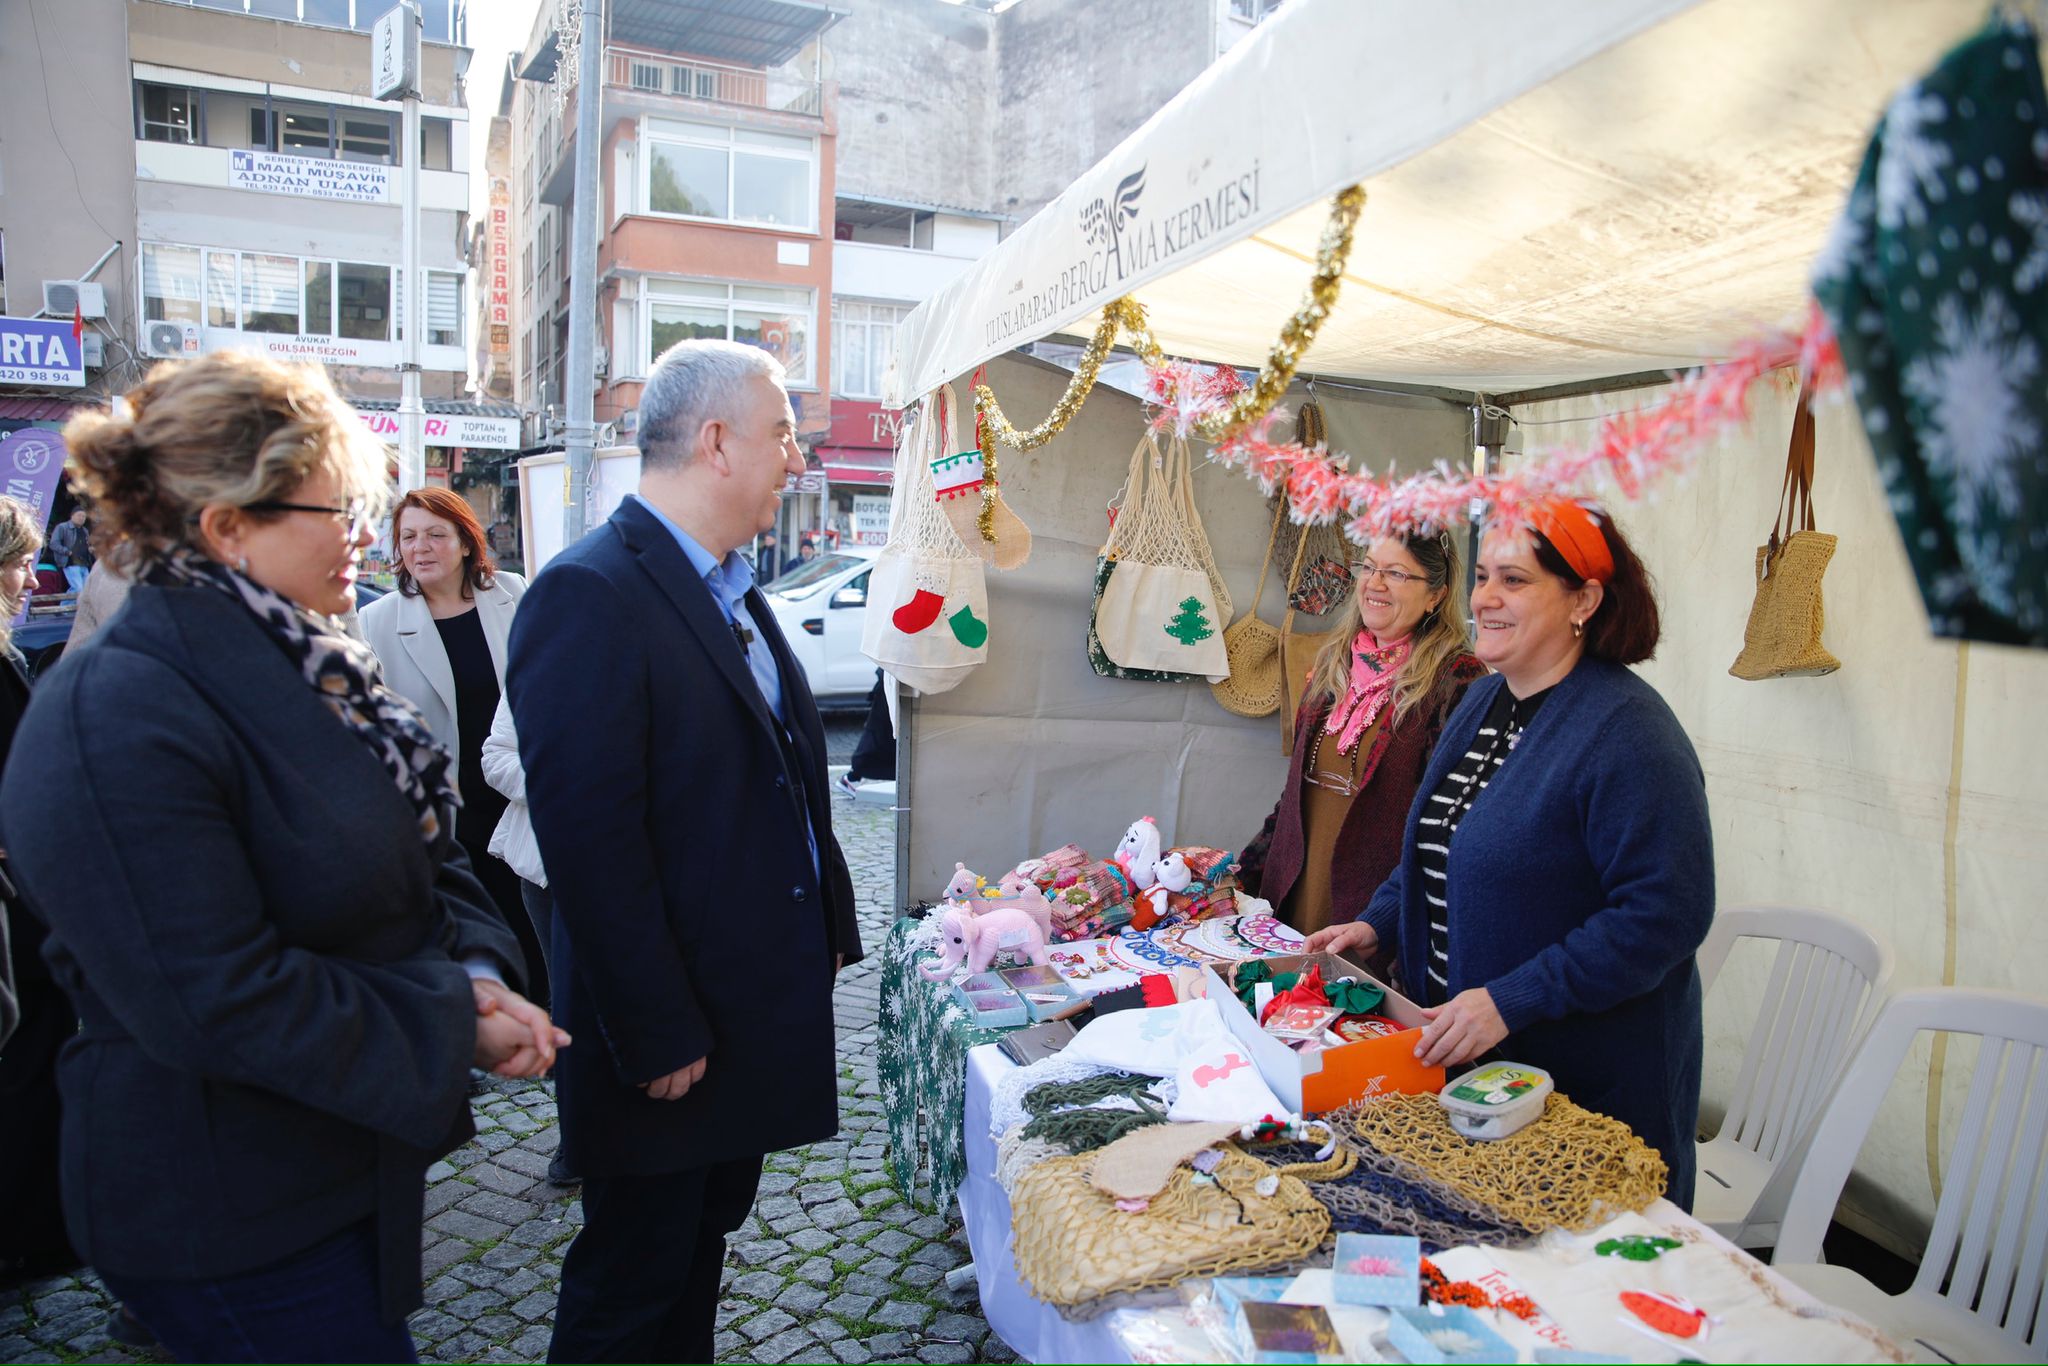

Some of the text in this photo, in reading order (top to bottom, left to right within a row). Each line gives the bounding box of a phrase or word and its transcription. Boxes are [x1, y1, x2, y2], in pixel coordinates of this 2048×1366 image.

[264, 155, 310, 165] SERBEST
[257, 163, 386, 184] MALİ MÜŞAVİR
[238, 172, 382, 195] ADNAN ULAKA
[986, 159, 1261, 347] ULUSLARARASI BERGAMA KERMESİ
[492, 209, 508, 321] BERGAMA
[295, 336, 331, 345] AVUKAT
[1, 332, 70, 367] RTA
[30, 371, 48, 381] 98
[52, 372, 70, 382] 94
[463, 422, 496, 432] TOPTAN
[461, 434, 508, 444] PARAKENDE
[860, 517, 878, 527] TEK
